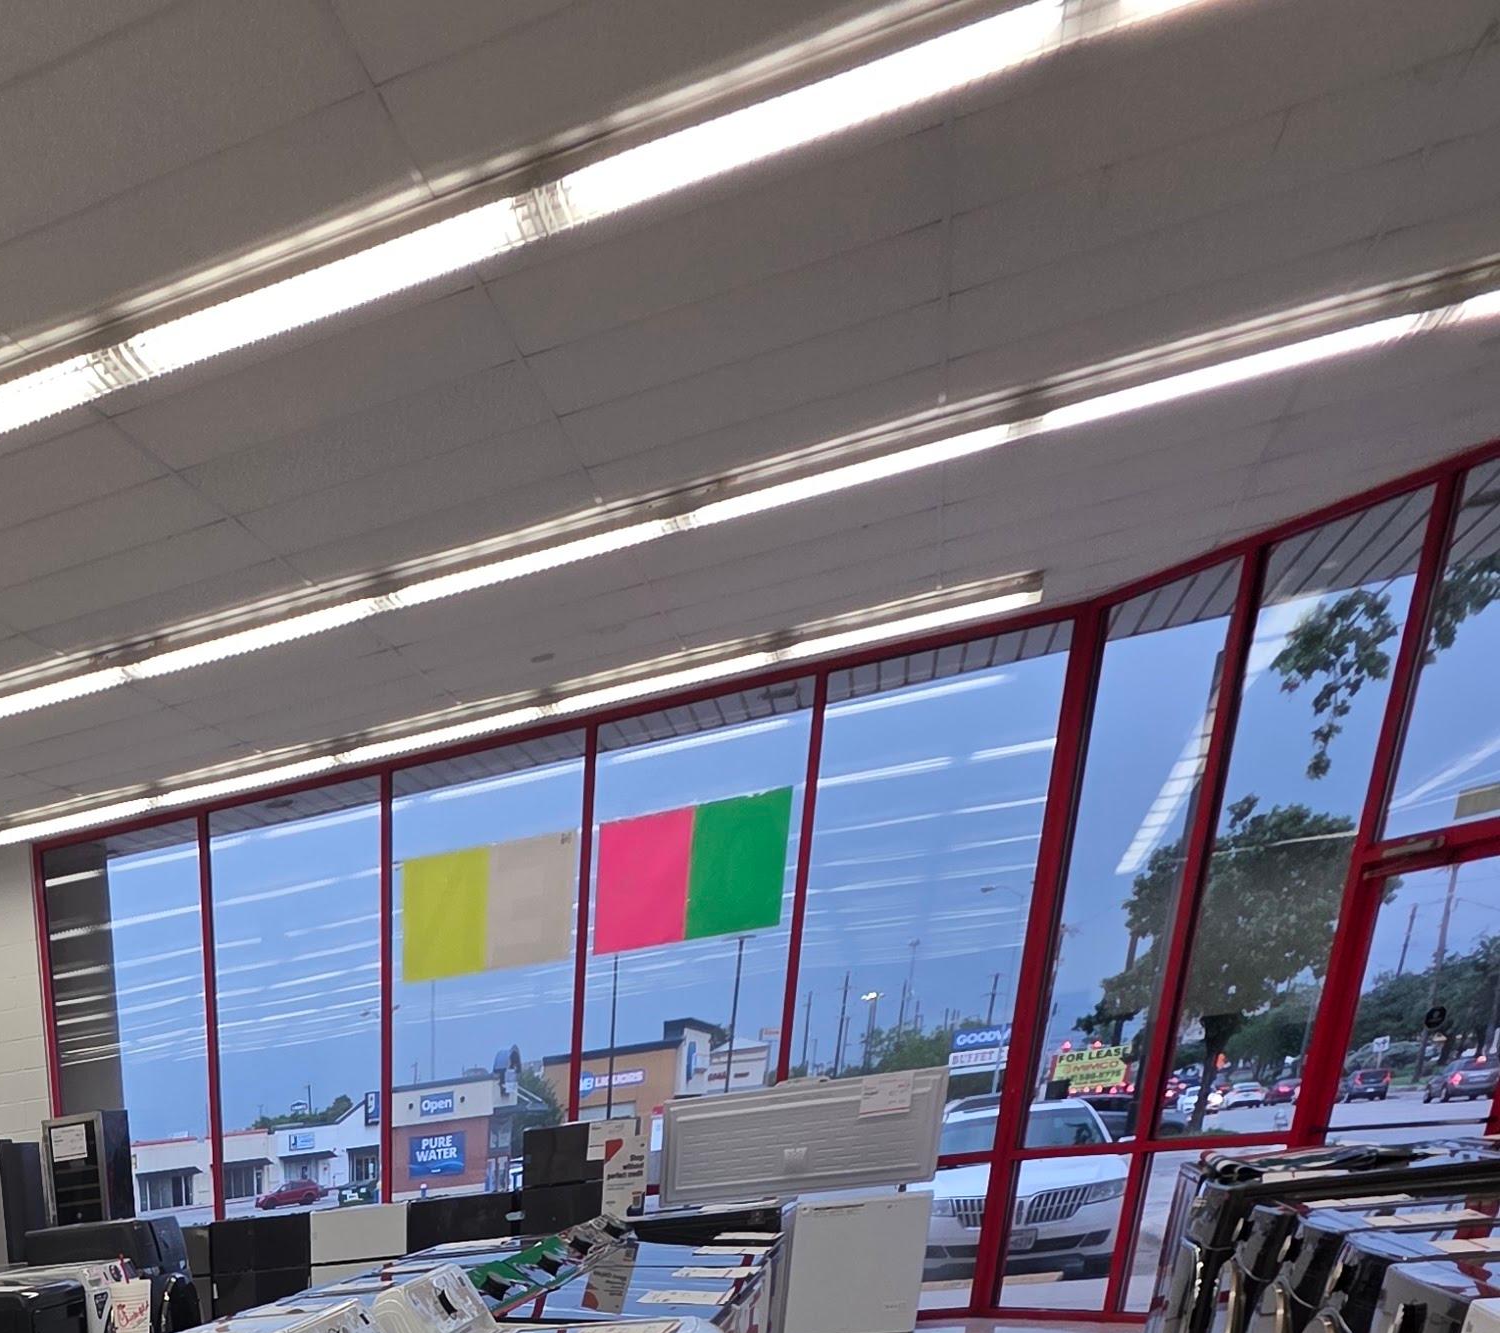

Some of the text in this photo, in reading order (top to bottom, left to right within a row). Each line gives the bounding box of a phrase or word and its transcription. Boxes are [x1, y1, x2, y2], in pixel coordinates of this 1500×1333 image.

[1059, 1052, 1084, 1064] FOR
[422, 1097, 453, 1113] Open
[421, 1135, 453, 1150] PURE
[416, 1147, 457, 1163] WATER
